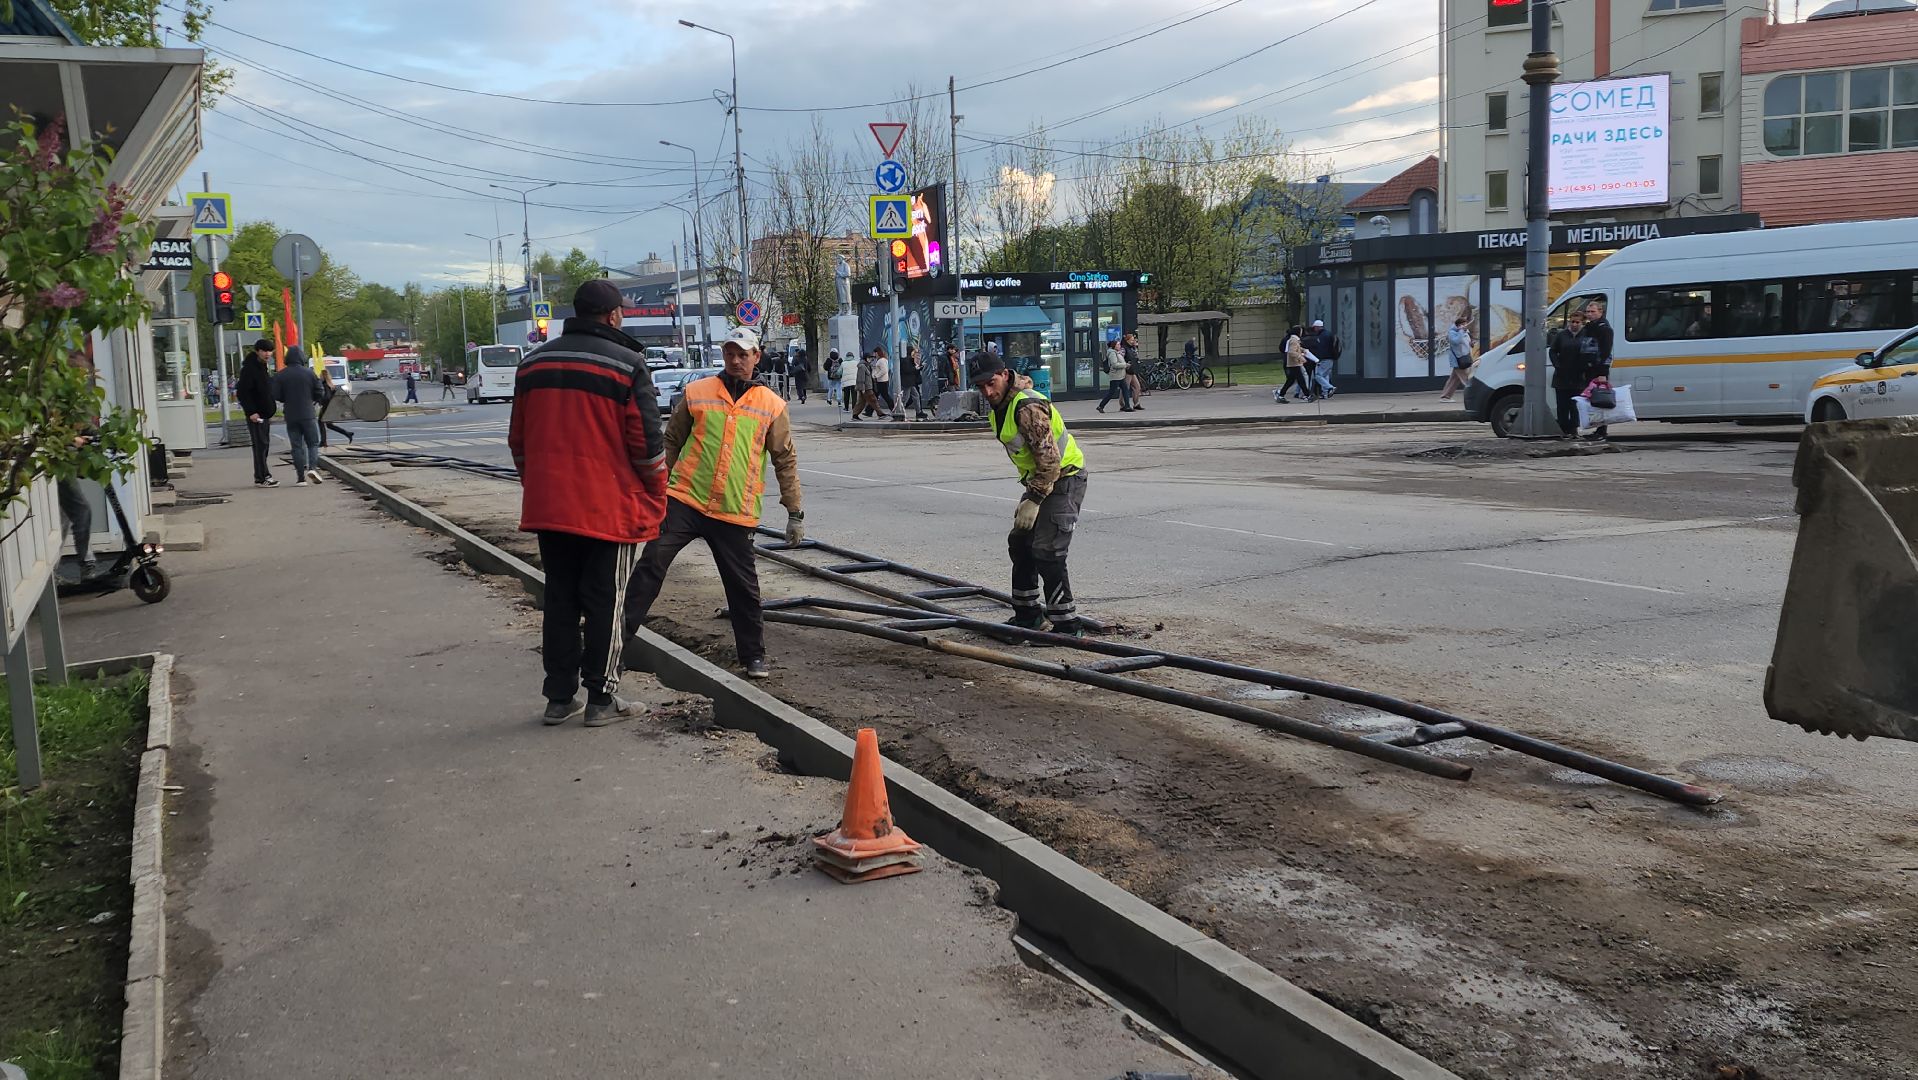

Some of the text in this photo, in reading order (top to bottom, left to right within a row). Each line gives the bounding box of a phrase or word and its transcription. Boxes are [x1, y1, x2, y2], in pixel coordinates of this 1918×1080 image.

[1551, 126, 1663, 145] РАЧИ ЗДЕСЬ
[1478, 224, 1661, 249] ПЕКАР МЕЛЬНИЦА
[151, 241, 190, 253] АБАК
[159, 256, 191, 266] ЧАСА
[994, 277, 1022, 287] coffee
[1050, 280, 1128, 290] РЕМОНТ ТЕЛЕФОНОВ
[942, 304, 977, 315] СТОП
